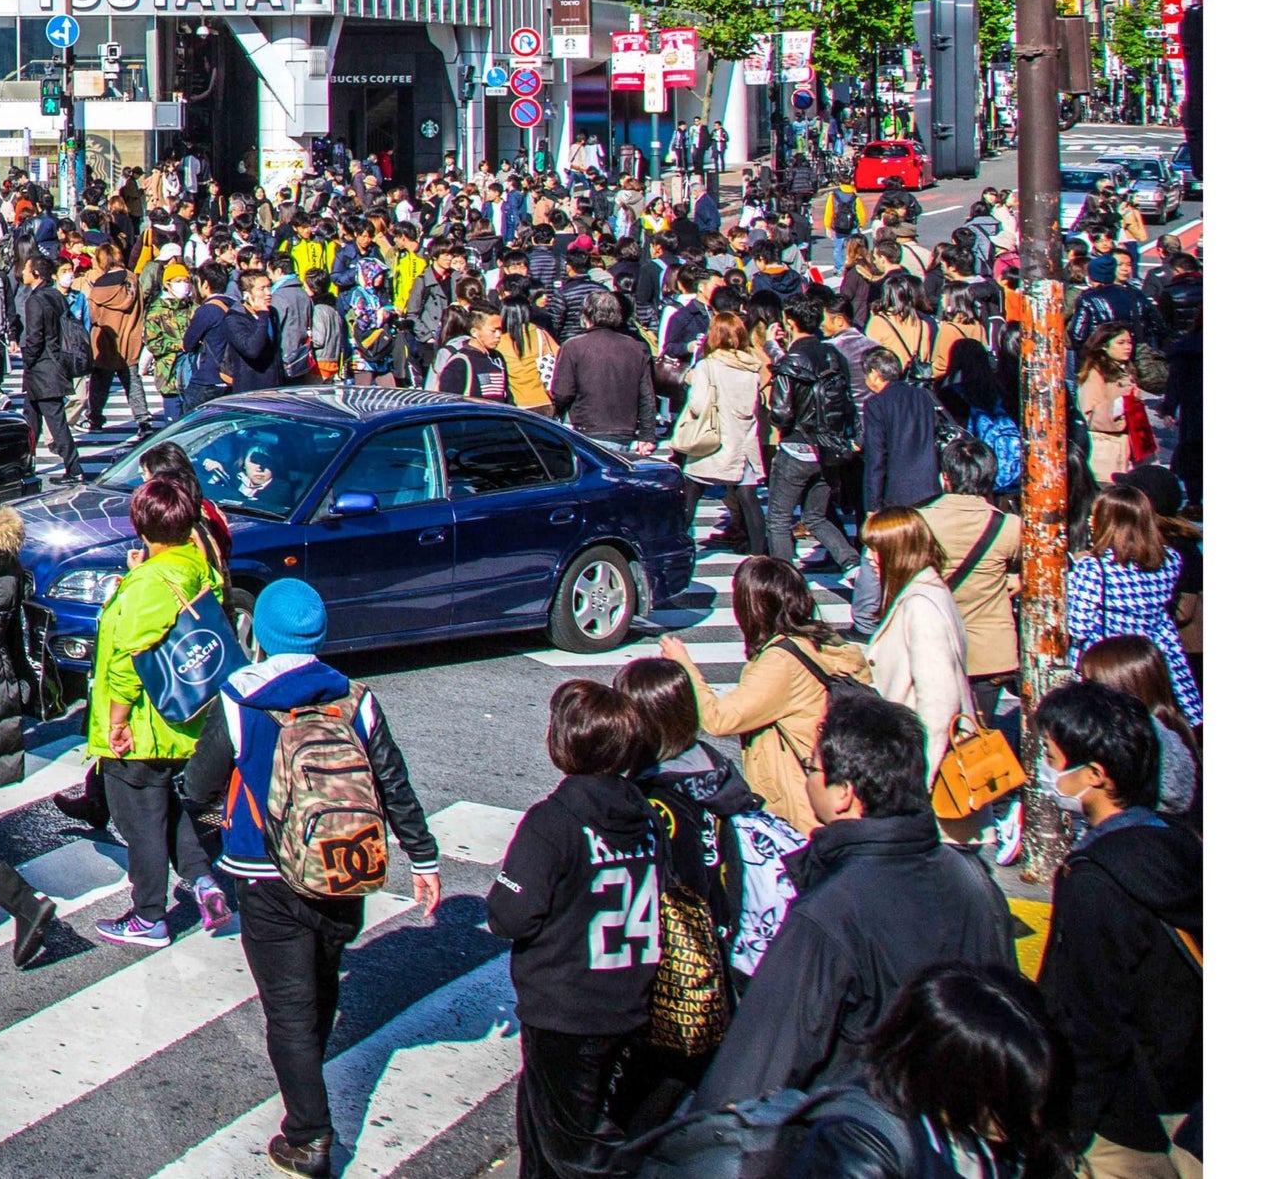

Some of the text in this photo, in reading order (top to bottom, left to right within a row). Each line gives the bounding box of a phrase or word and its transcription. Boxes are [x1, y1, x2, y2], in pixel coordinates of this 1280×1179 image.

[369, 75, 413, 84] COFFEE
[178, 638, 219, 675] COACH
[588, 866, 662, 970] 24
